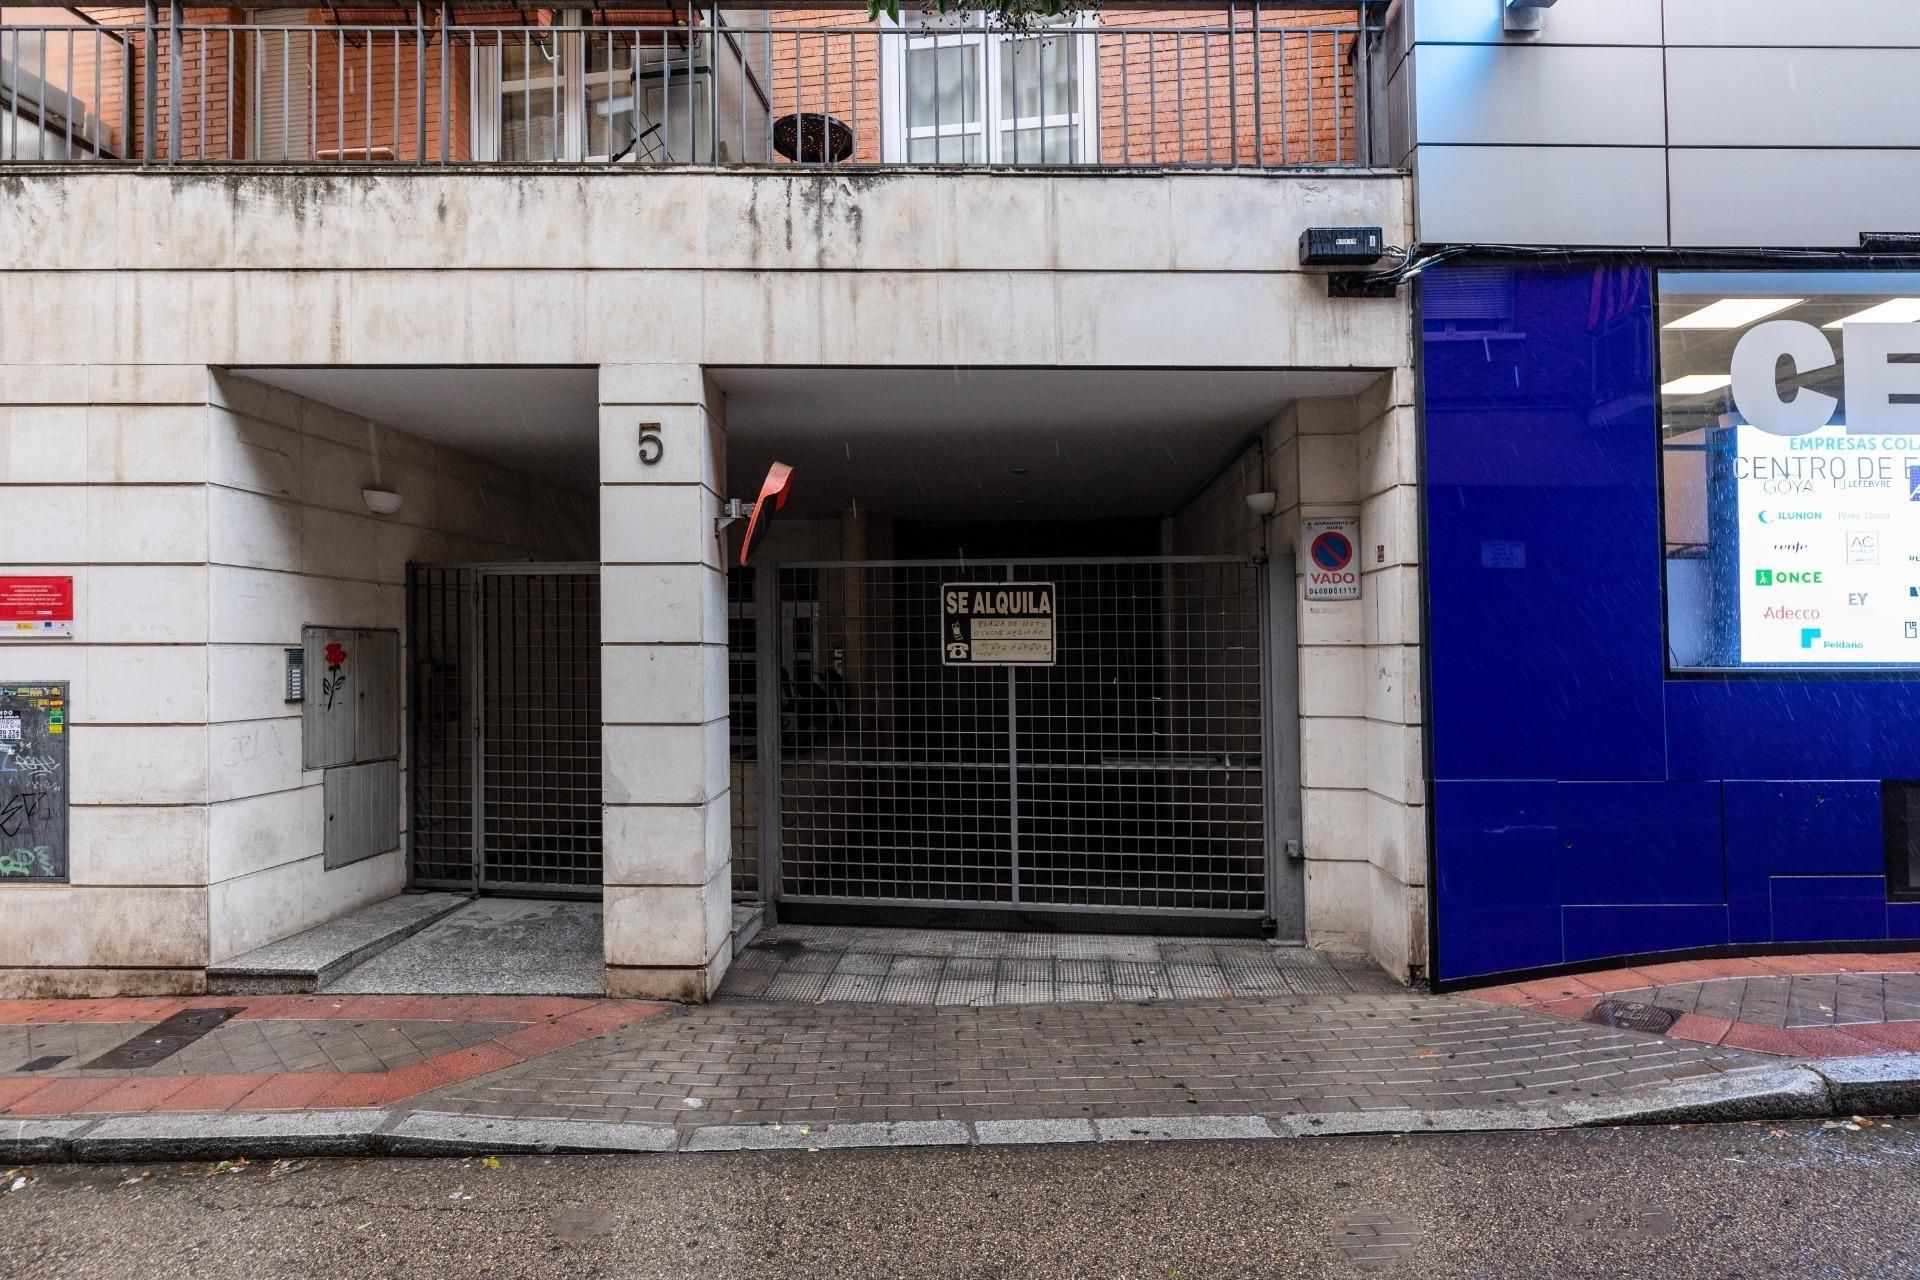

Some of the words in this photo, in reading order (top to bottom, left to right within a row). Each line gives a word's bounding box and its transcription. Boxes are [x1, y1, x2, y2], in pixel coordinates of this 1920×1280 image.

[638, 422, 664, 466] 5
[1790, 438, 1876, 450] EMPRESAS
[1732, 456, 1846, 480] CENTRO
[1857, 456, 1893, 480] DE
[1763, 480, 1815, 495] GOYA
[1778, 511, 1822, 520] ILUNION
[1311, 573, 1355, 584] VADO
[1776, 572, 1823, 583] ONCE
[946, 591, 969, 614] SE
[973, 591, 1052, 616] ALQUILA
[1848, 592, 1868, 606] EY
[1763, 606, 1820, 620] Adecco
[1823, 640, 1864, 649] Peldaño
